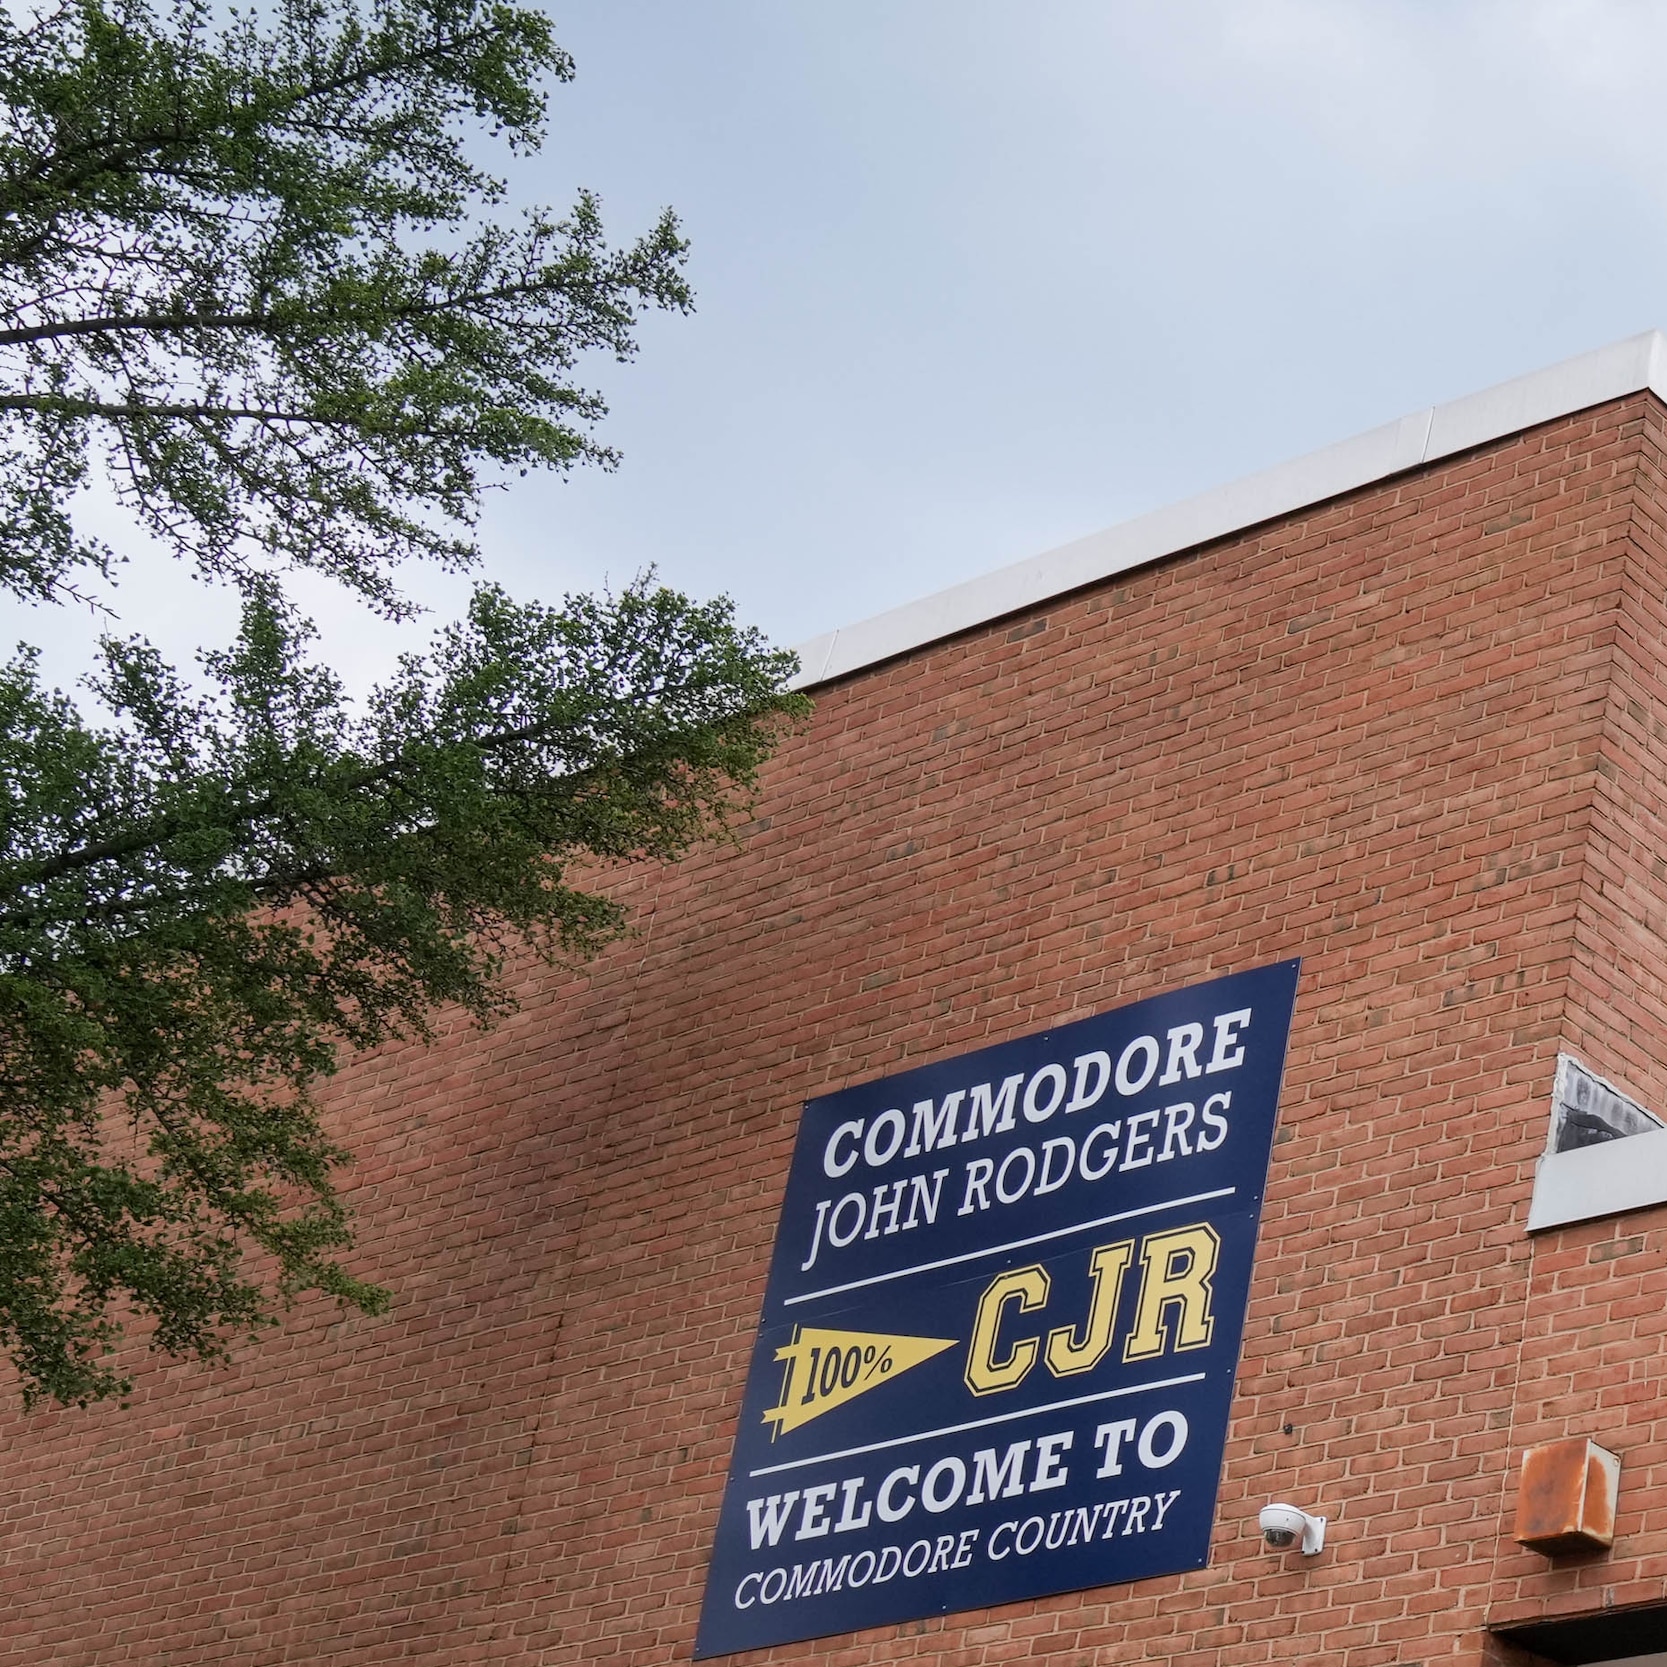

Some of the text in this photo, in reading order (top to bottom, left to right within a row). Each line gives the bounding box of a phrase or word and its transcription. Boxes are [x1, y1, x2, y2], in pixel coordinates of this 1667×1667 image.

[823, 1008, 1252, 1179] COMMODORE
[802, 1092, 1232, 1271] JOHN RODGERS
[802, 1344, 892, 1406] 100%
[964, 1222, 1221, 1398] CJR
[734, 1491, 1181, 1609] COMMODORE COUNTRY
[747, 1409, 1188, 1550] WELCOME TO
